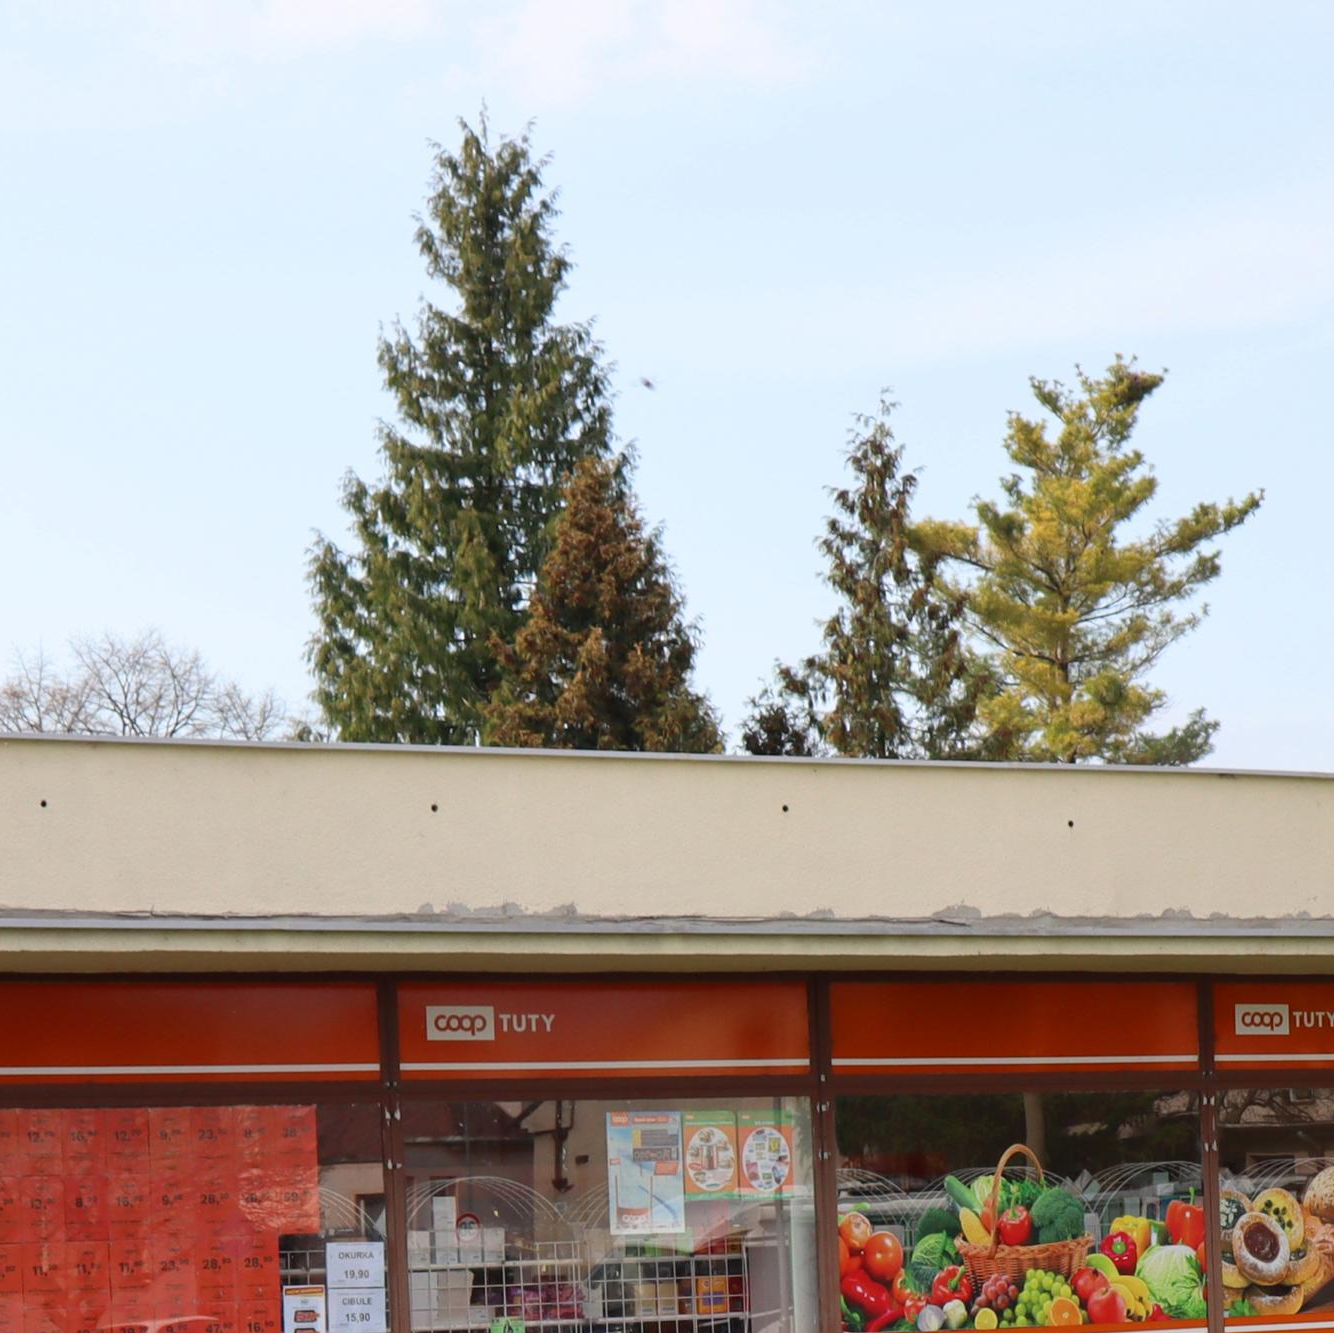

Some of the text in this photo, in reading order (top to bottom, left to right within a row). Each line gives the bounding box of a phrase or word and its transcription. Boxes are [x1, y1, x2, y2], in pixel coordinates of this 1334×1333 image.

[434, 1013, 555, 1036] coop TUTY
[1241, 1011, 1283, 1031] coop
[338, 1251, 374, 1260] OKURKA
[344, 1270, 369, 1280] 19,90
[342, 1297, 373, 1305] CIBULE
[345, 1313, 371, 1323] 15,90
